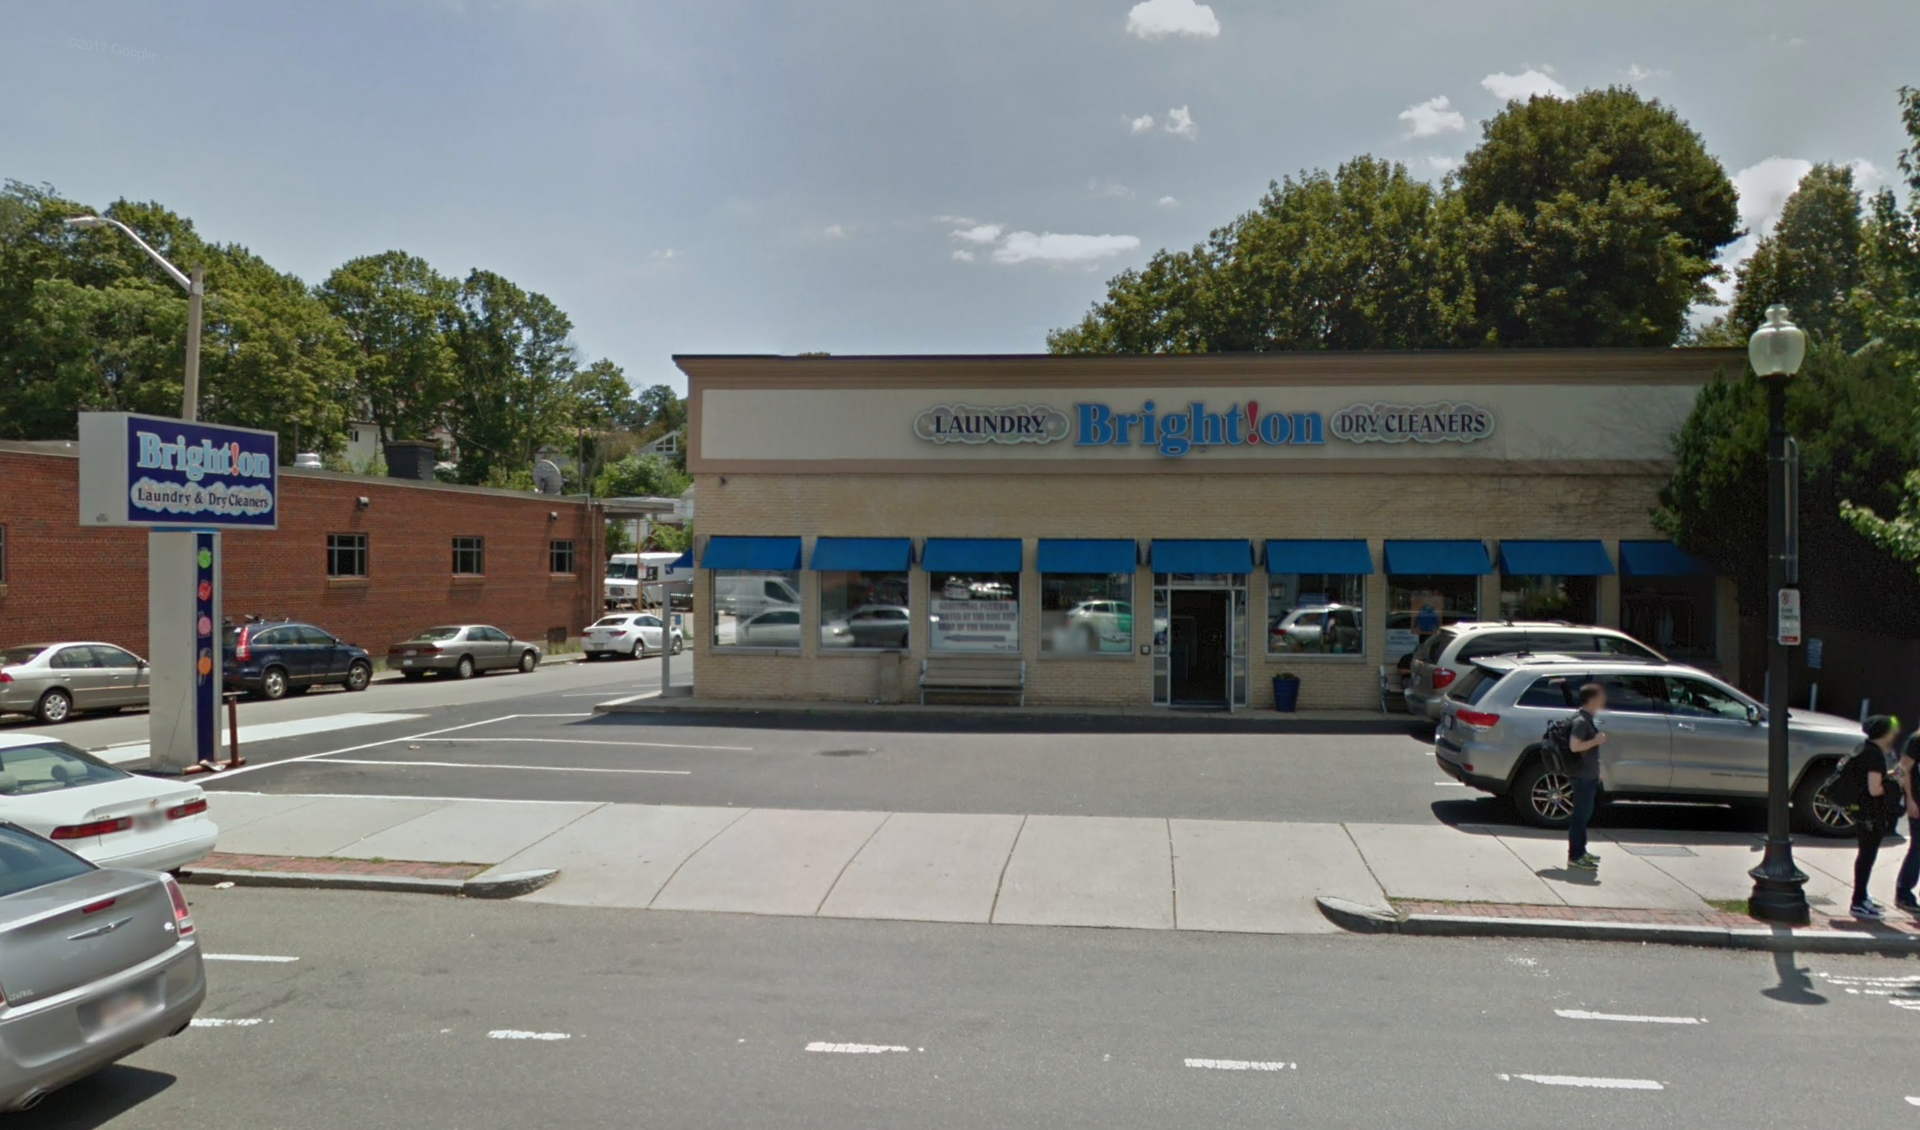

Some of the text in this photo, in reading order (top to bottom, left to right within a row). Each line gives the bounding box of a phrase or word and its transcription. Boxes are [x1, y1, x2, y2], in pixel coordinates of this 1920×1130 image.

[934, 413, 1046, 434] LAUNDRY
[1340, 412, 1486, 434] DRY CLEANERS
[137, 486, 269, 509] Laundry & Dry Cleaners
